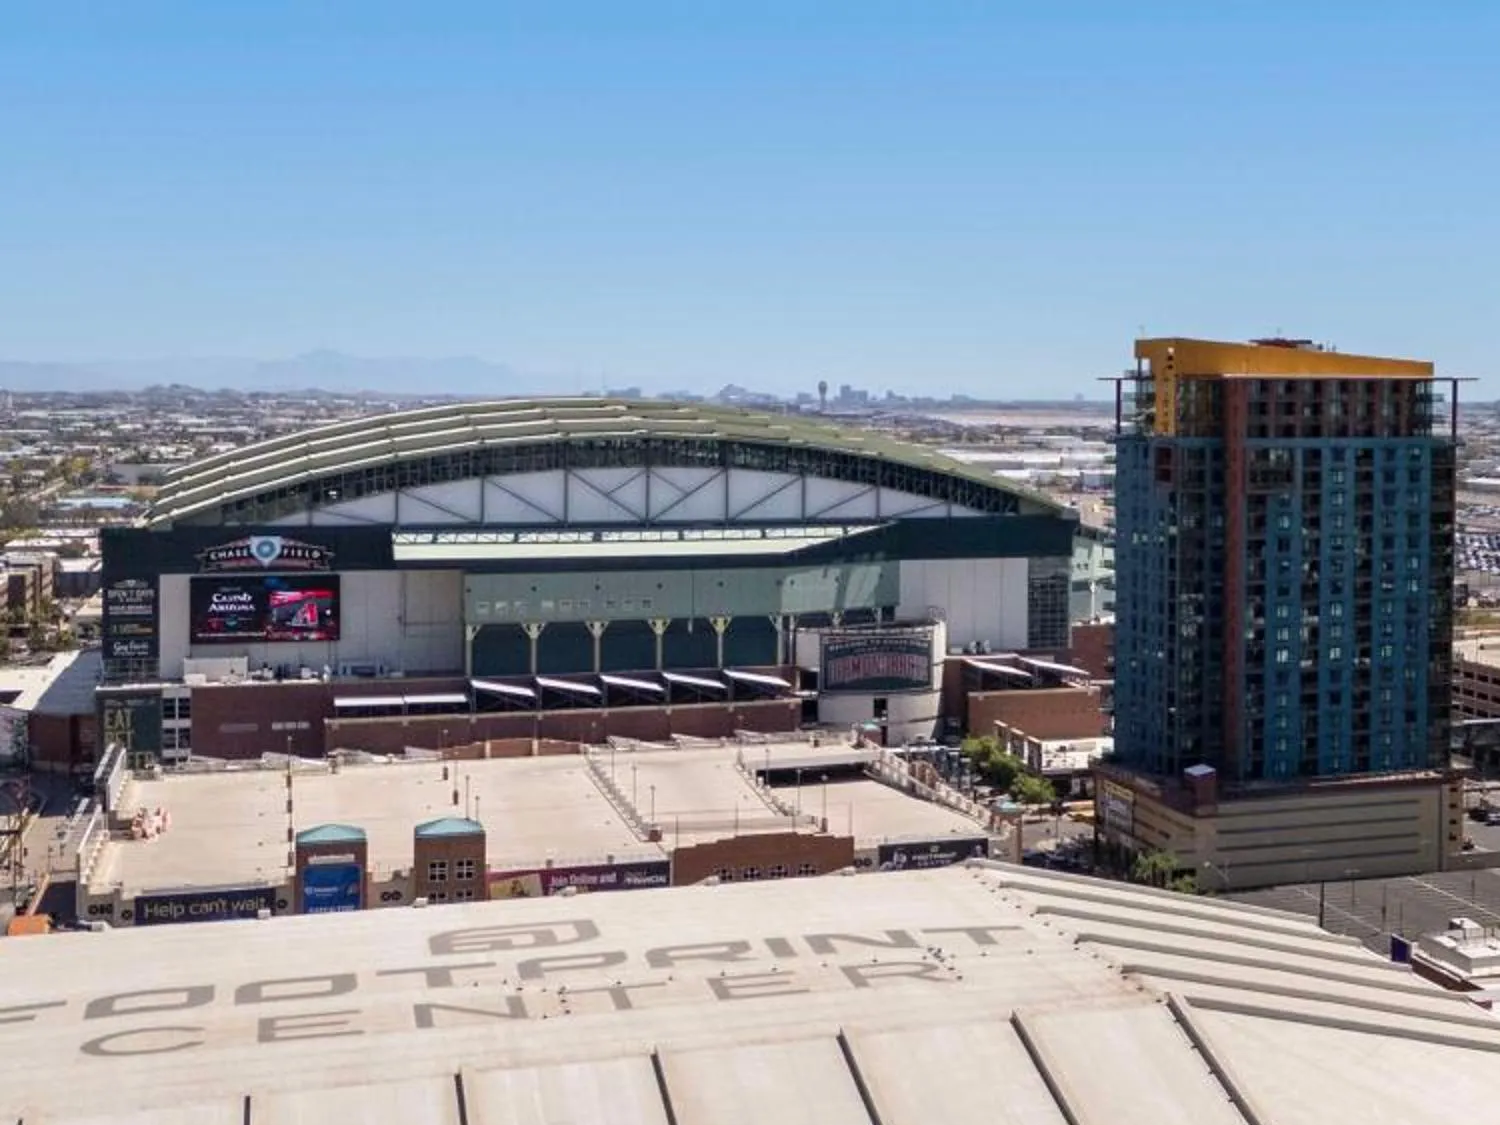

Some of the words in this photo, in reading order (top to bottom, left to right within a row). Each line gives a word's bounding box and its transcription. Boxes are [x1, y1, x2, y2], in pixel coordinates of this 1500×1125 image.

[209, 547, 249, 560] CHASE
[282, 547, 321, 559] FIELD
[143, 900, 185, 919] Help
[80, 961, 957, 1056] CENTER
